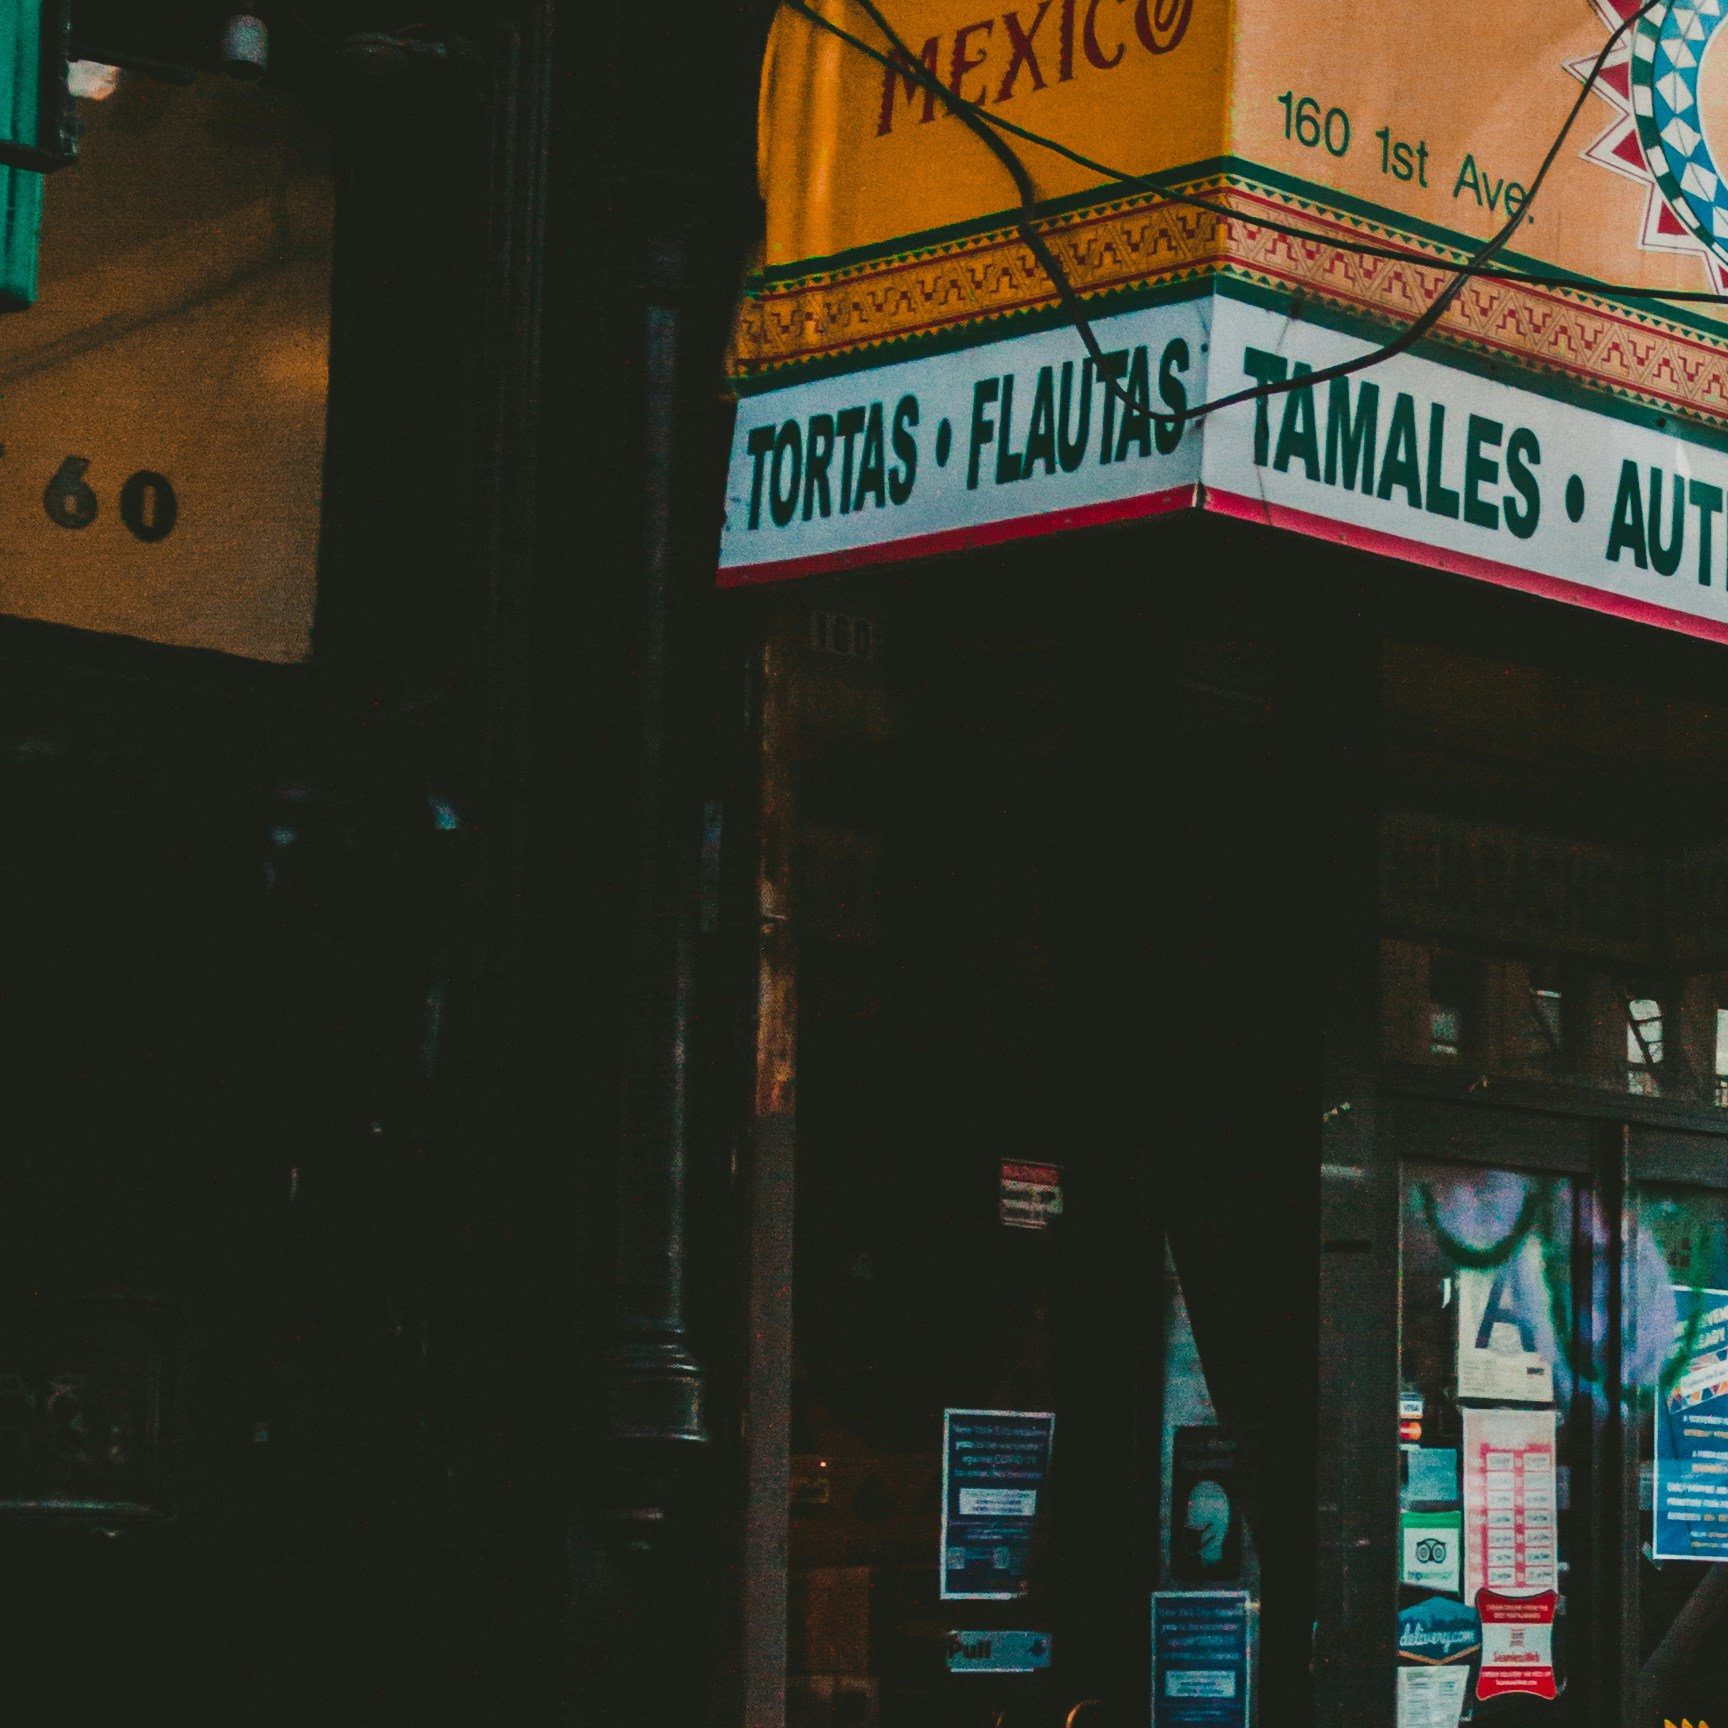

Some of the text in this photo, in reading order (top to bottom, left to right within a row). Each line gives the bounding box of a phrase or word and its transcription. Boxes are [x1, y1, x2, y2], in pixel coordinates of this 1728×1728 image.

[1278, 91, 1350, 158] 160
[1375, 126, 1431, 190] 1st
[747, 337, 1190, 531] TORTAS FLAUTAS
[1245, 347, 1541, 538] TAMALES
[1400, 1623, 1475, 1653] delivery.com
